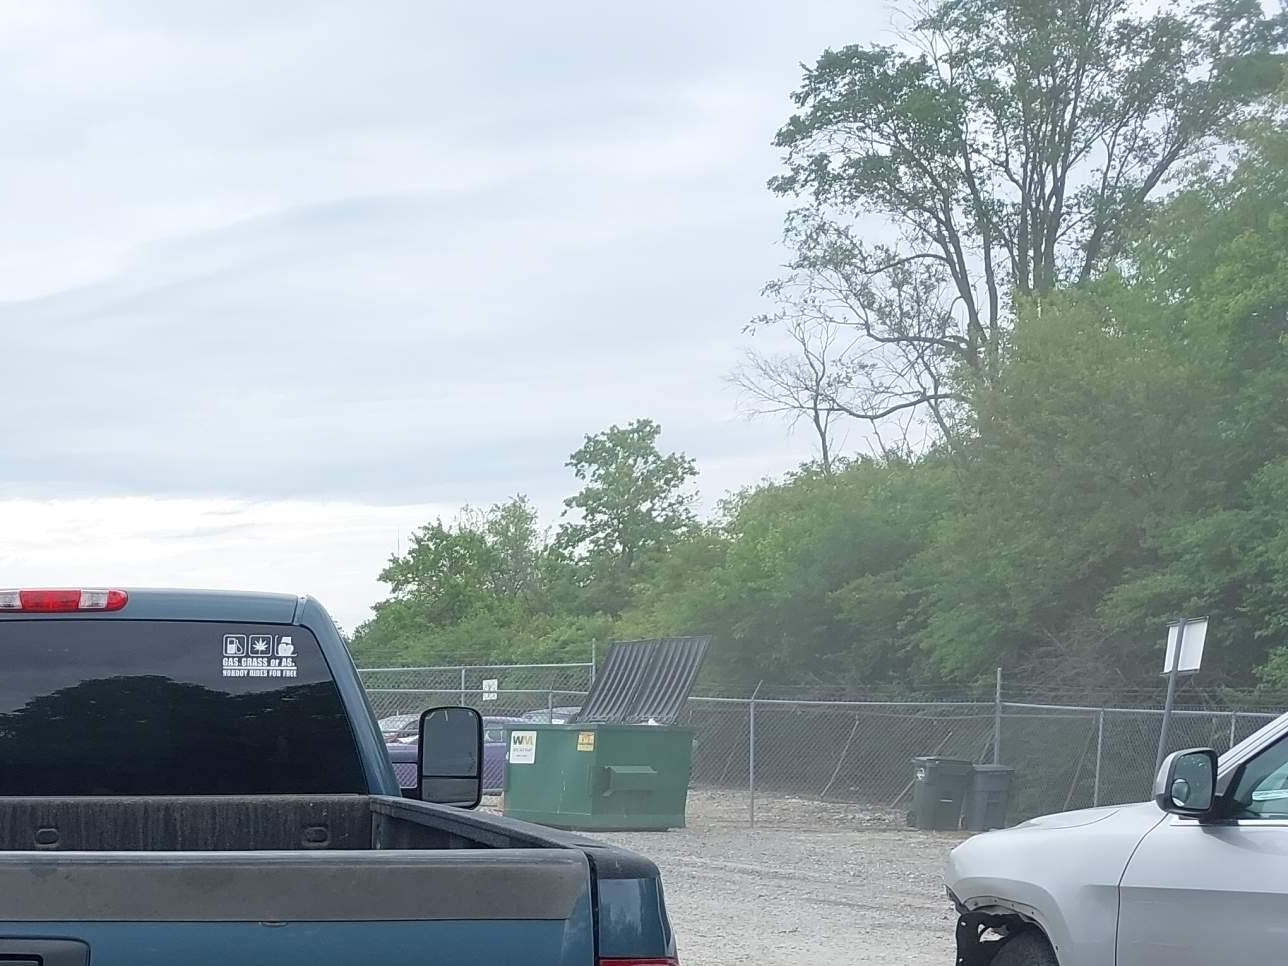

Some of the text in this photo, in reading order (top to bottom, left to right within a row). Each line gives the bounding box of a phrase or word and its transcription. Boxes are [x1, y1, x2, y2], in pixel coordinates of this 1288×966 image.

[242, 658, 268, 667] GRASS
[222, 669, 248, 677] NOBODY
[269, 669, 281, 677] FOR
[282, 669, 297, 677] FREE
